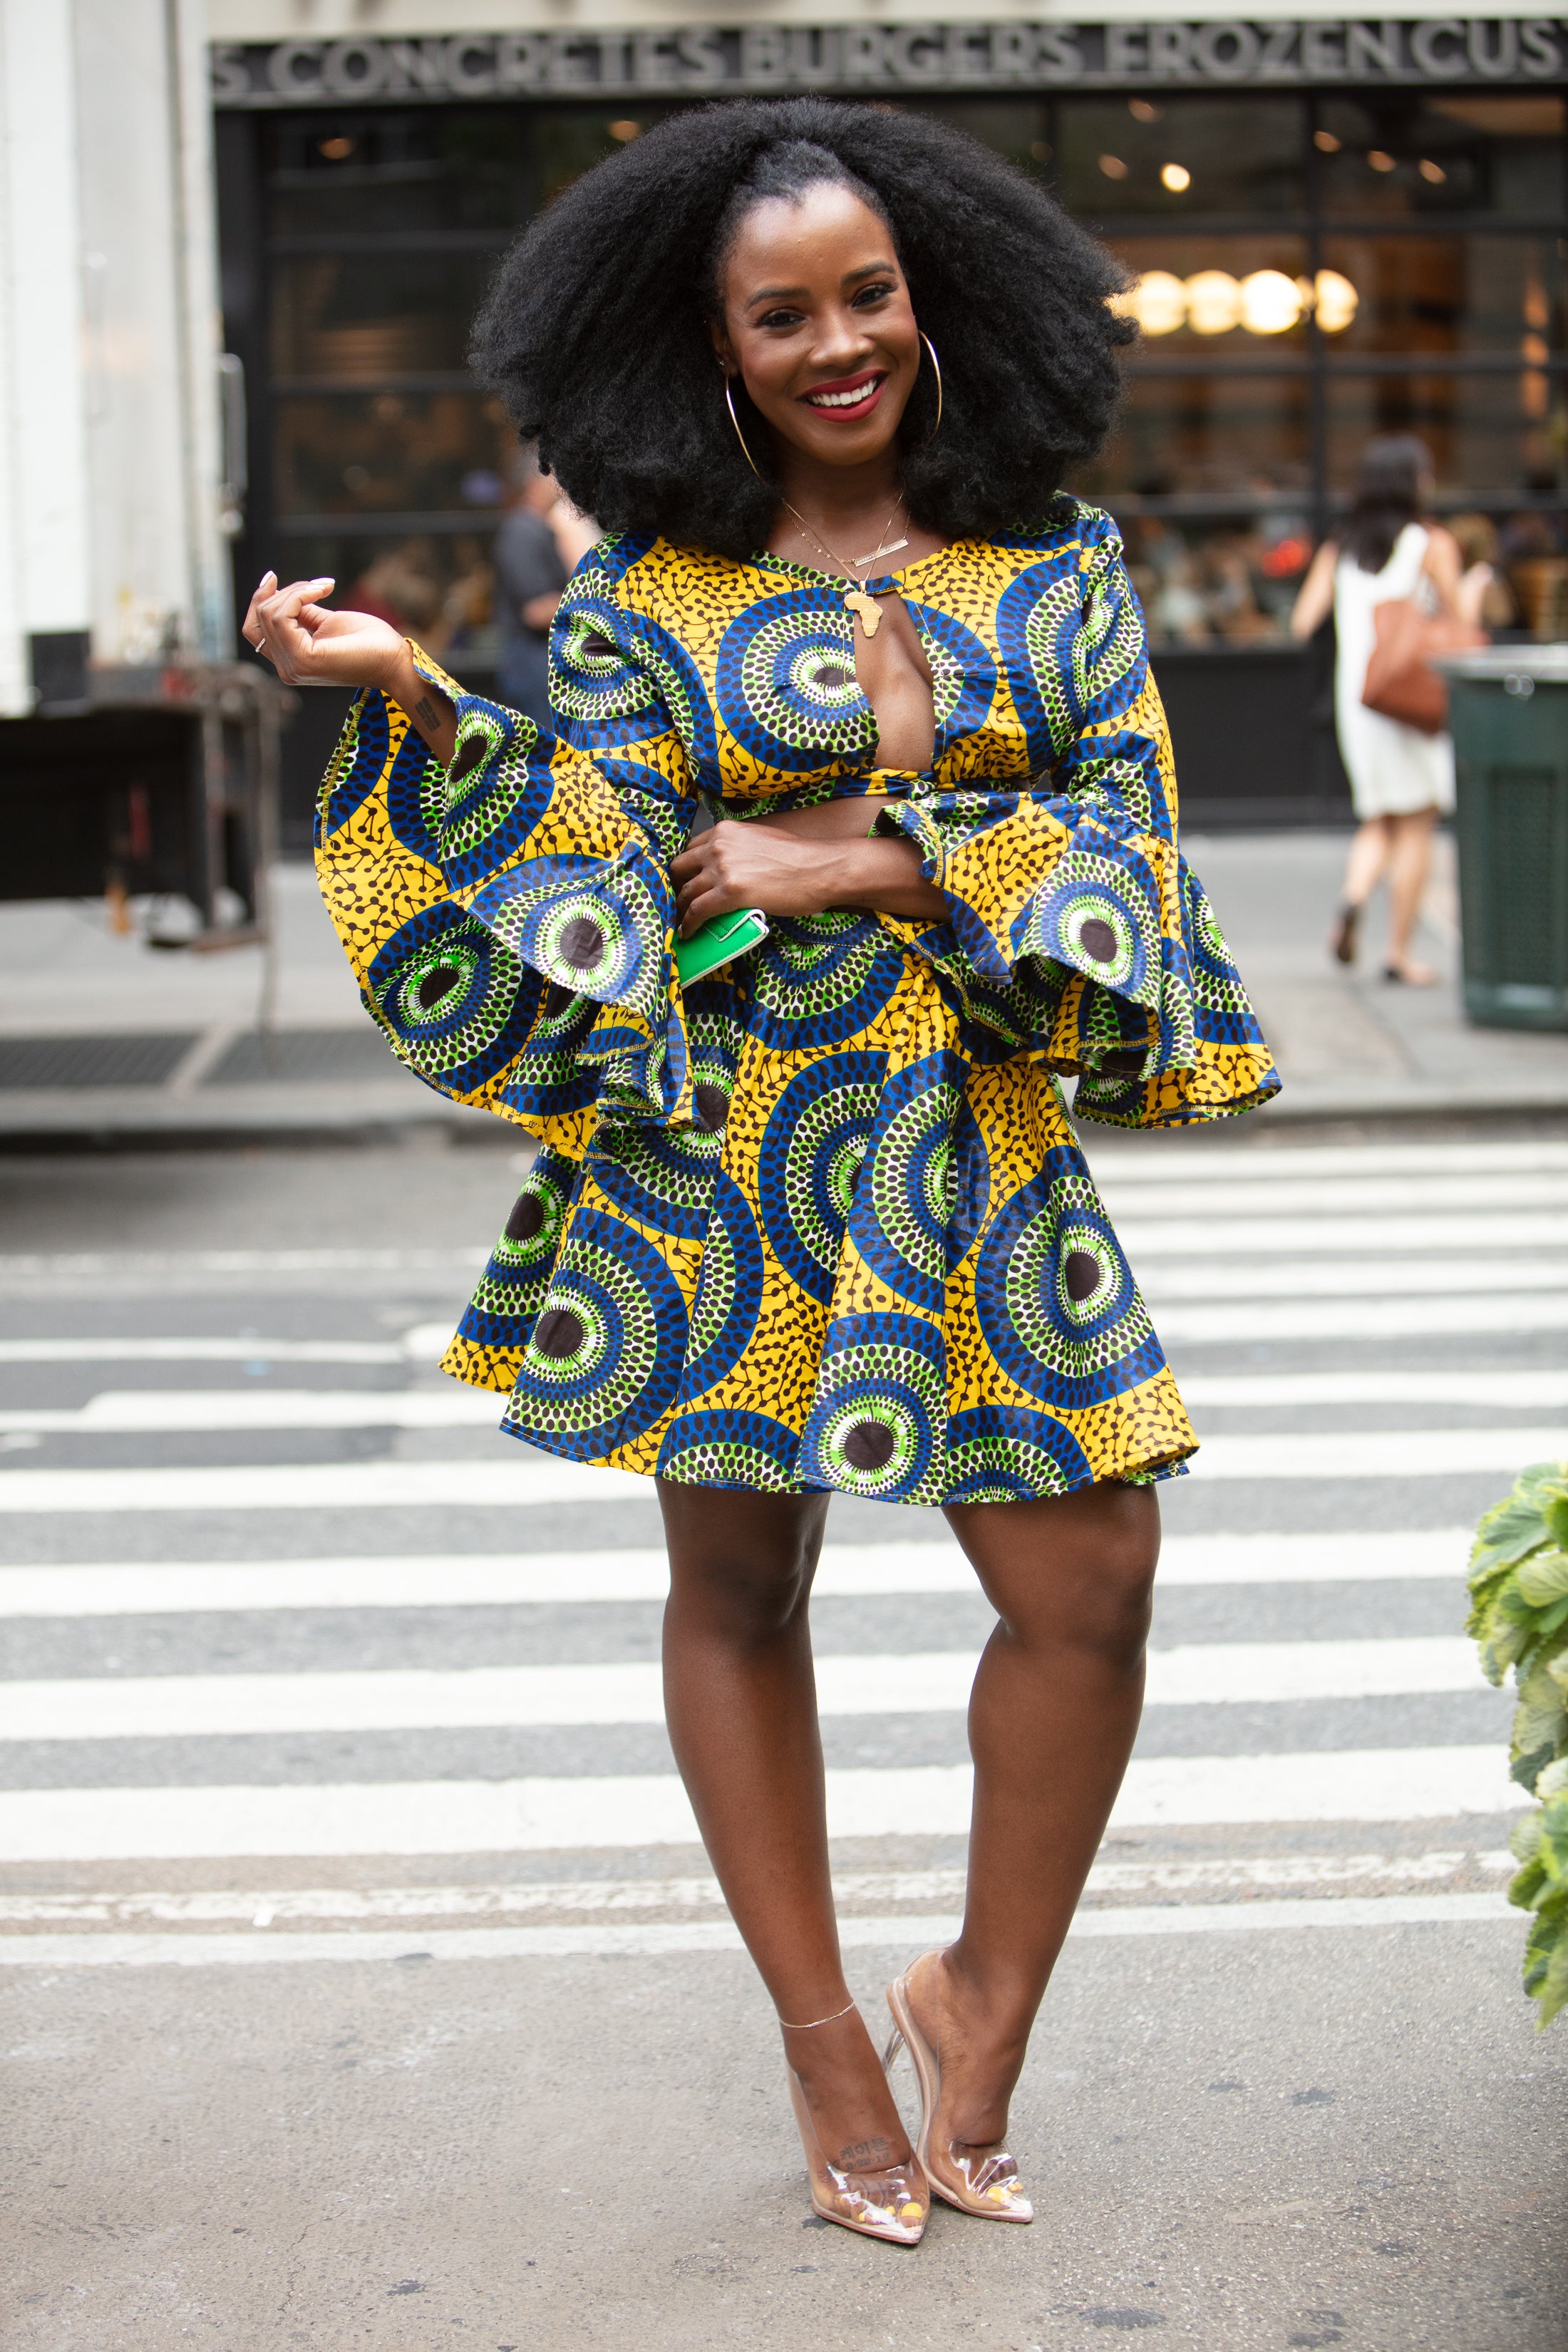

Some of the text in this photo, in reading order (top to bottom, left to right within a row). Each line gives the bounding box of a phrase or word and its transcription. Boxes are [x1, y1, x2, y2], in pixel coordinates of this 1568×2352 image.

[267, 26, 727, 102] CONCRETES
[740, 21, 1085, 89] BURGERS
[1104, 19, 1404, 83] FROZEN
[1410, 17, 1568, 78] CUS
